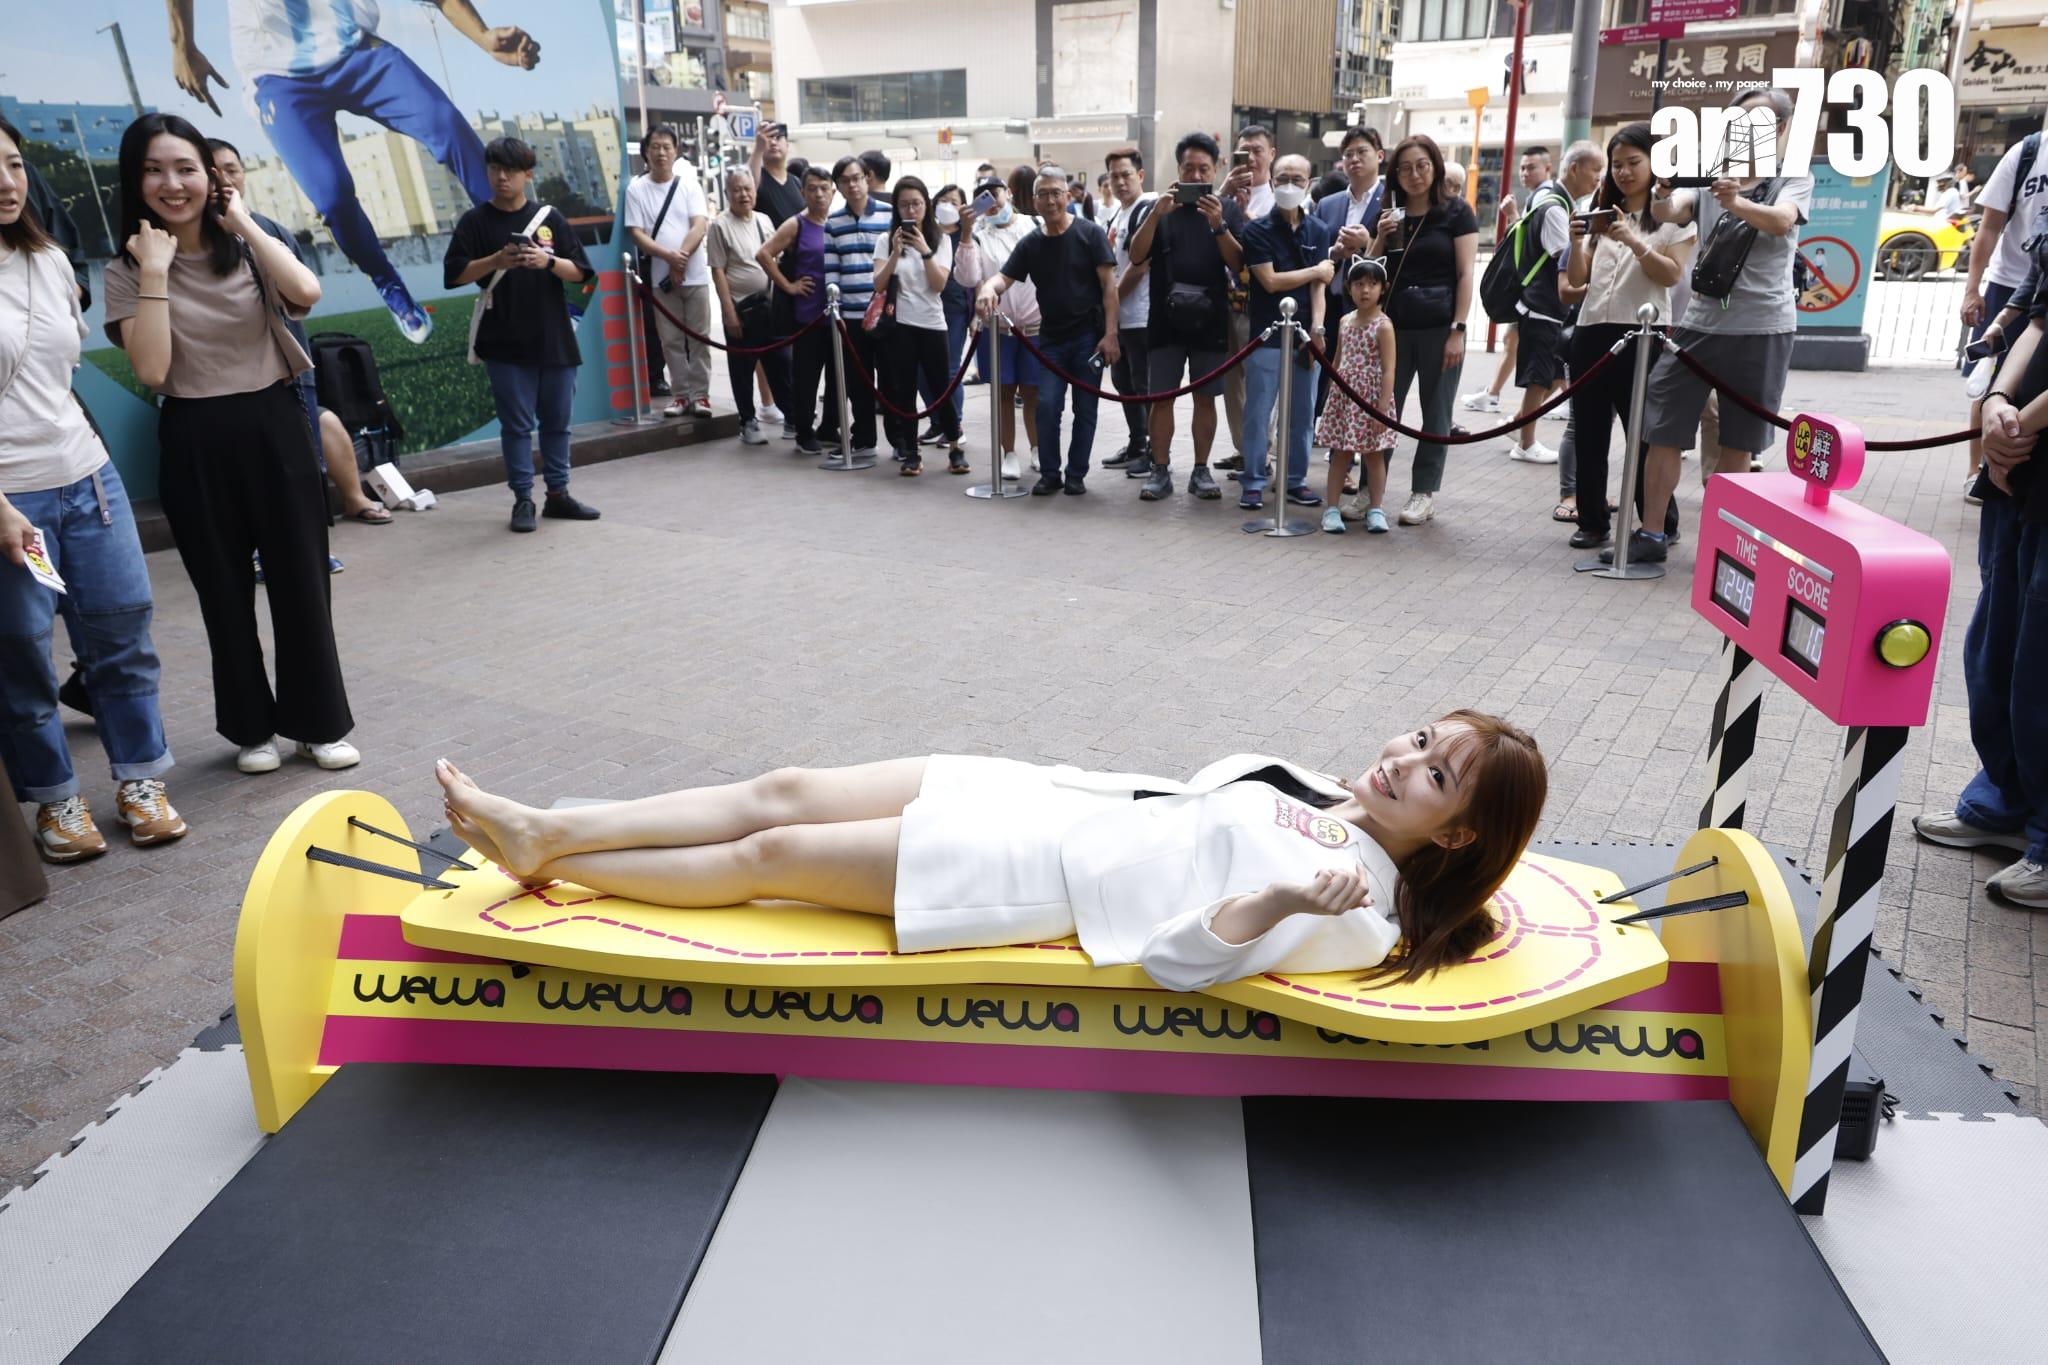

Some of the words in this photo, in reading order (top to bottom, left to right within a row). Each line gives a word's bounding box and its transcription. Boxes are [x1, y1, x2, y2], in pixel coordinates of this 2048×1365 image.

[1736, 534, 1758, 566] TIME
[1787, 566, 1830, 612] SCORE
[354, 973, 506, 1009] wewa
[538, 980, 693, 1016] wewa
[725, 988, 883, 1025] wewa
[917, 997, 1080, 1032] wewa
[1113, 1004, 1281, 1041] wewa
[1525, 1022, 1705, 1061] wewa
